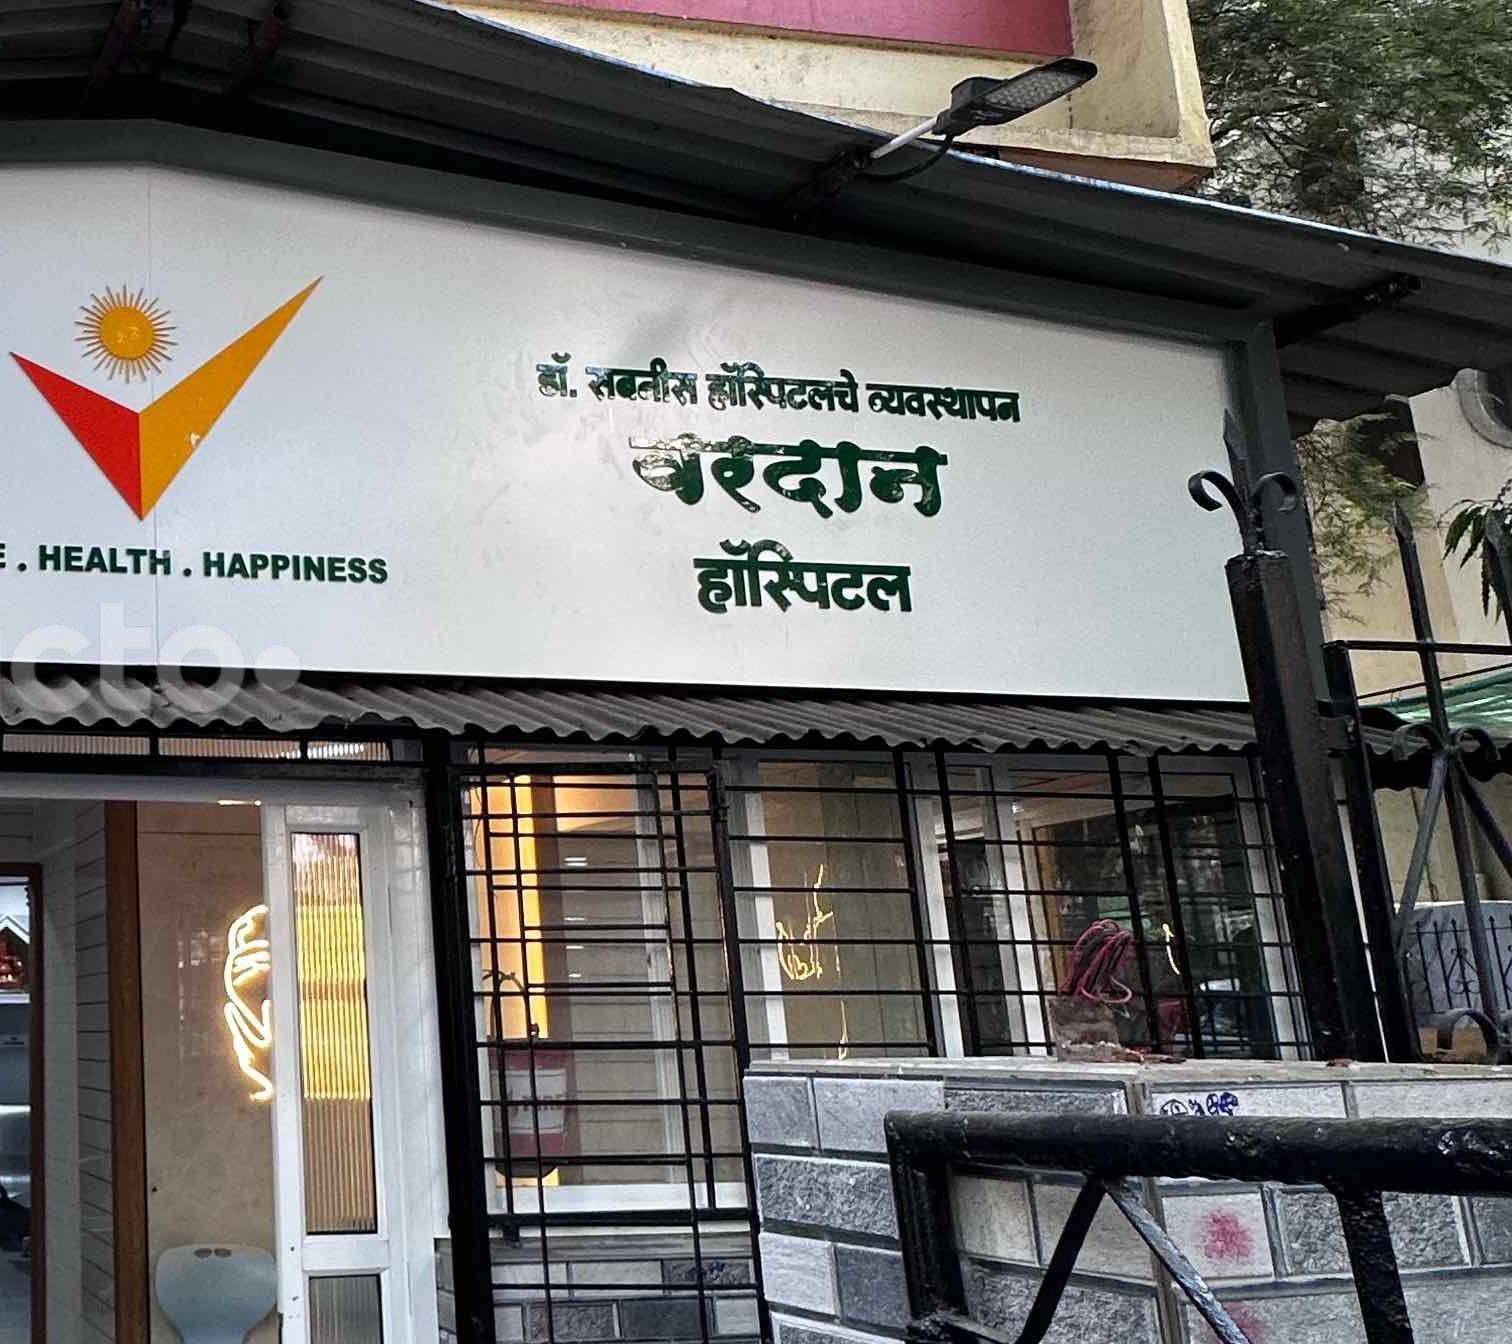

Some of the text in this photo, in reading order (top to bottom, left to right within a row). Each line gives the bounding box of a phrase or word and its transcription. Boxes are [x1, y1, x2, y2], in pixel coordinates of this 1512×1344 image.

[705, 362, 860, 413] हॉस्पिटलचे
[865, 383, 1021, 423] व्यवस्थापन
[629, 433, 948, 519] वरदान
[38, 544, 171, 576] HEALTH
[202, 551, 388, 585] HAPPINESS
[693, 539, 913, 614] हॉस्पिटल
